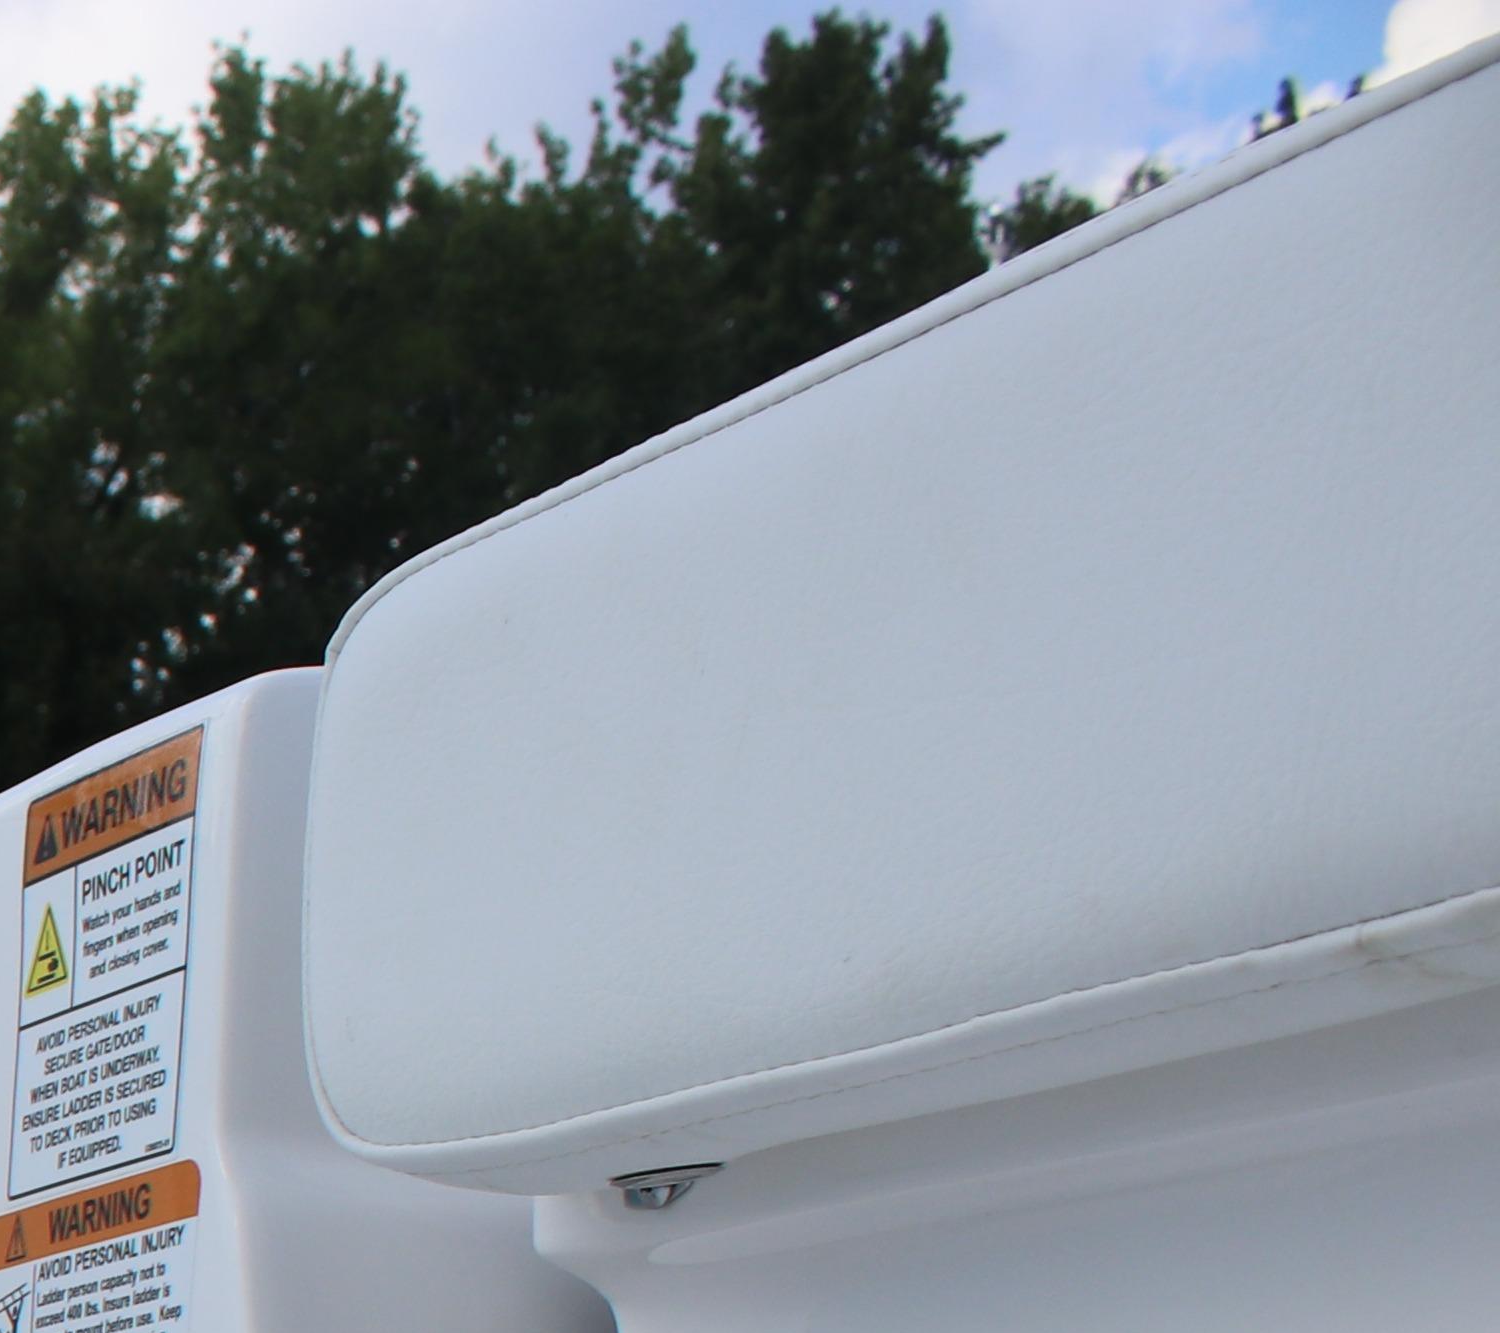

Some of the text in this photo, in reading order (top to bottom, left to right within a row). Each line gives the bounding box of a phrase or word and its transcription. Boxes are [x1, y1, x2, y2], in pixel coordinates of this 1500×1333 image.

[60, 758, 187, 849] WARNING
[81, 838, 186, 905] PINCH POINT
[36, 993, 161, 1053] AVOID PERSONAL INJURY
[43, 1024, 145, 1076] SECURE GATE/DOOR
[22, 1068, 167, 1132] ENSURE LADDER IS SECURED
[30, 1045, 160, 1103] WHEN BOAT IS UNDERWAY.
[30, 1097, 156, 1152] TO DECK PRIOR TO USING
[57, 1151, 67, 1169] IF
[68, 1134, 122, 1166] EQUIPPED.
[48, 1182, 151, 1244] WARNING
[37, 1224, 185, 1282] AVOID PERSONAL INJURY
